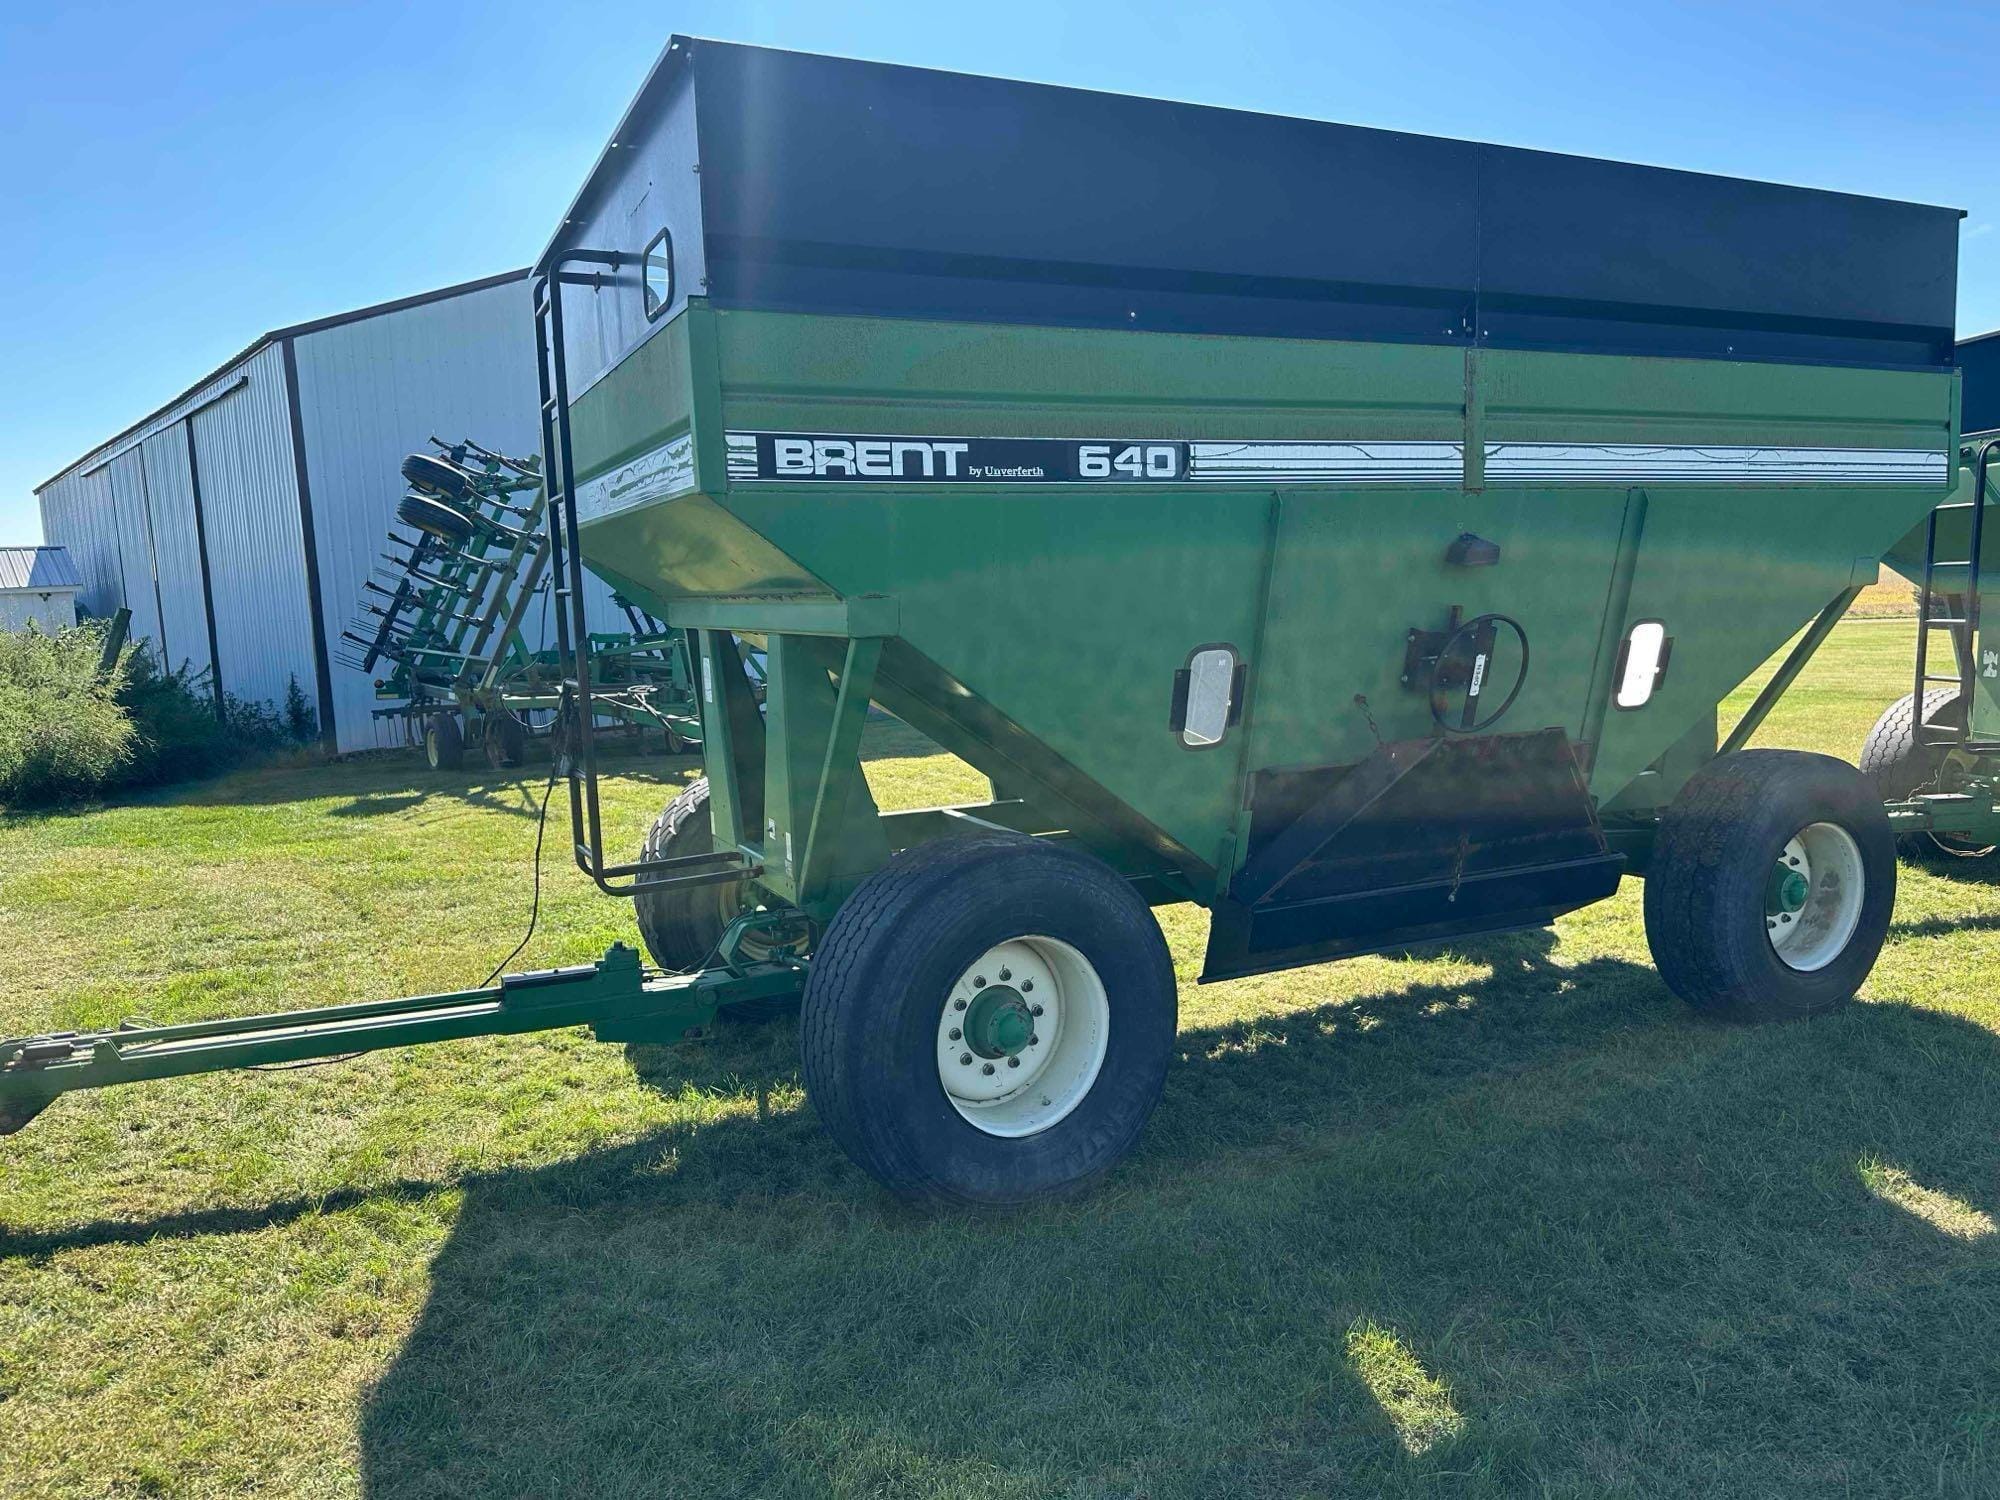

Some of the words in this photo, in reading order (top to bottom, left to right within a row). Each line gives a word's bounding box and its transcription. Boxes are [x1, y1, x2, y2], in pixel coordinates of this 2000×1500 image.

[774, 438, 969, 476] BRENT
[968, 466, 982, 478] by
[984, 466, 1044, 477] Unverferth
[1078, 445, 1176, 477] 640
[1473, 664, 1483, 686] OPEN
